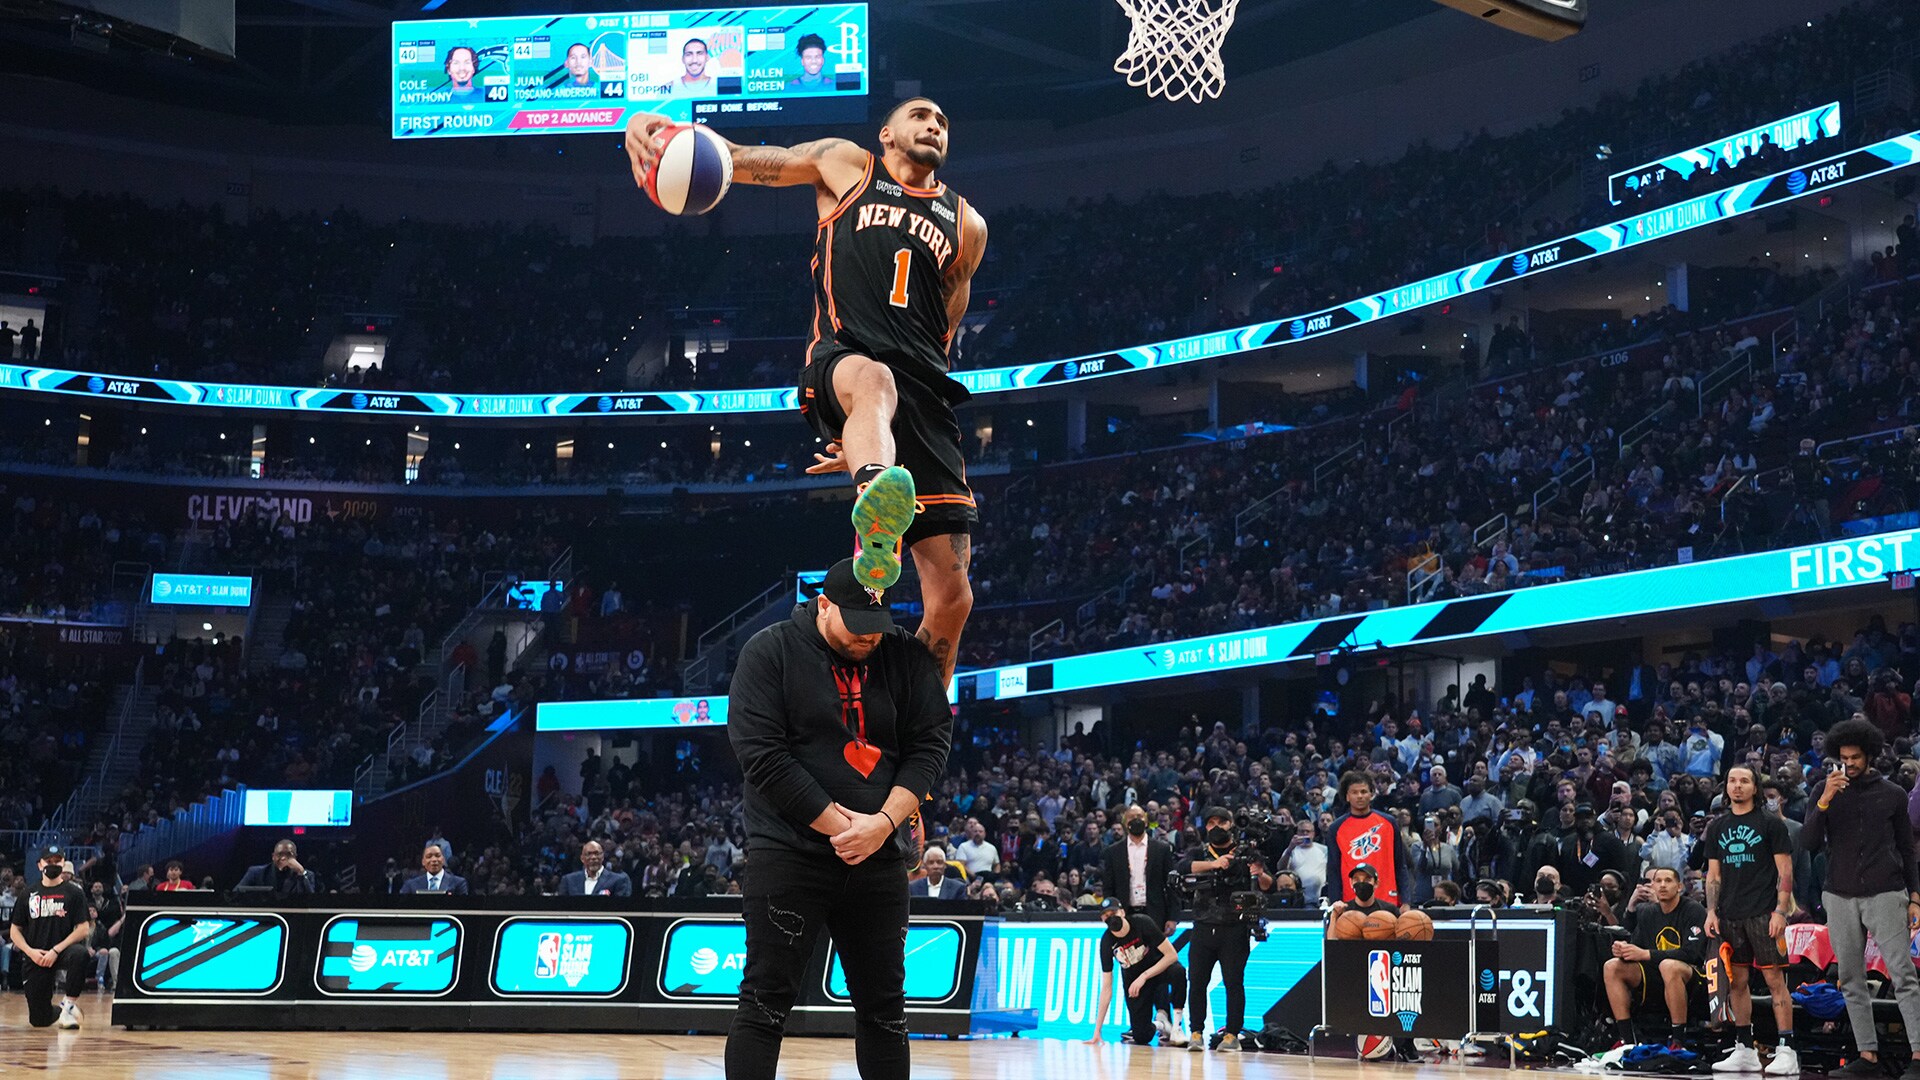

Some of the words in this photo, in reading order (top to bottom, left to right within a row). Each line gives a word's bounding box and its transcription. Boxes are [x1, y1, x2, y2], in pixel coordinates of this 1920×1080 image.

[600, 18, 619, 27] AT&T
[400, 49, 416, 60] 40
[516, 46, 531, 56] 44
[630, 73, 649, 82] OBI
[748, 68, 784, 79] JALEN
[400, 80, 427, 91] COLE
[514, 76, 544, 87] JUAN
[748, 81, 785, 92] GREEN
[487, 86, 507, 100] 40
[514, 87, 597, 99] TOSCANO-ANDERSON
[604, 82, 623, 97] 44
[631, 85, 672, 95] TOPPIN
[400, 92, 452, 104] ANTHONY
[696, 104, 718, 114] BEEN
[721, 103, 743, 112] DONE
[747, 102, 783, 112] BEFORE.
[400, 116, 440, 129] FIRST
[444, 114, 493, 128] ROUND
[526, 113, 549, 125] TOP
[551, 113, 559, 124] 2
[561, 112, 613, 124] ADVANCE
[1774, 116, 1811, 149] DUNK
[856, 203, 907, 232] NEW
[908, 210, 952, 270] YORK
[889, 248, 912, 308] 1
[978, 372, 1001, 389] DUNK
[1079, 359, 1105, 375] AT&T
[1178, 341, 1201, 360] SLAM
[1202, 336, 1227, 355] DUNK
[1307, 315, 1332, 332] AT&T
[1401, 285, 1423, 307] SLAM
[1425, 279, 1449, 300] DUNK
[1530, 247, 1560, 266] AT&T
[1646, 212, 1675, 236] SLAM
[1677, 205, 1707, 230] DUNK
[1809, 161, 1846, 186] AT&T
[1600, 356, 1607, 367] C
[1610, 351, 1628, 366] 106
[107, 381, 139, 394] AT&T
[227, 387, 251, 404] SLAM
[256, 389, 282, 406] DUNK
[370, 397, 400, 409] AT&T
[482, 397, 506, 414] SLAM
[508, 397, 534, 414] DUNK
[614, 397, 643, 410] AT&T
[721, 393, 746, 410] SLAM
[748, 392, 772, 408] DUNK
[188, 494, 312, 523] CLEVEAND
[343, 499, 377, 520] 2022
[1790, 534, 1912, 589] FIRST
[1896, 574, 1911, 588] EXIT
[174, 584, 203, 595] AT&T
[212, 585, 228, 596] SLAM
[230, 586, 247, 597] DUNK
[69, 629, 82, 642] ALL
[84, 630, 104, 643] STAR
[1178, 649, 1203, 663] AT&T
[1219, 640, 1240, 663] SLAM
[1243, 636, 1268, 660] DUNK
[1001, 676, 1024, 688] TOTAL
[1718, 825, 1762, 849] ALL-STAR
[382, 950, 434, 967] AT&T
[562, 943, 592, 961] SLAM
[1403, 953, 1422, 964] AT&T
[722, 953, 747, 970] AT
[1392, 966, 1422, 992] SLAM
[1392, 992, 1423, 1015] DUNK
[1478, 993, 1496, 1004] AT&T
